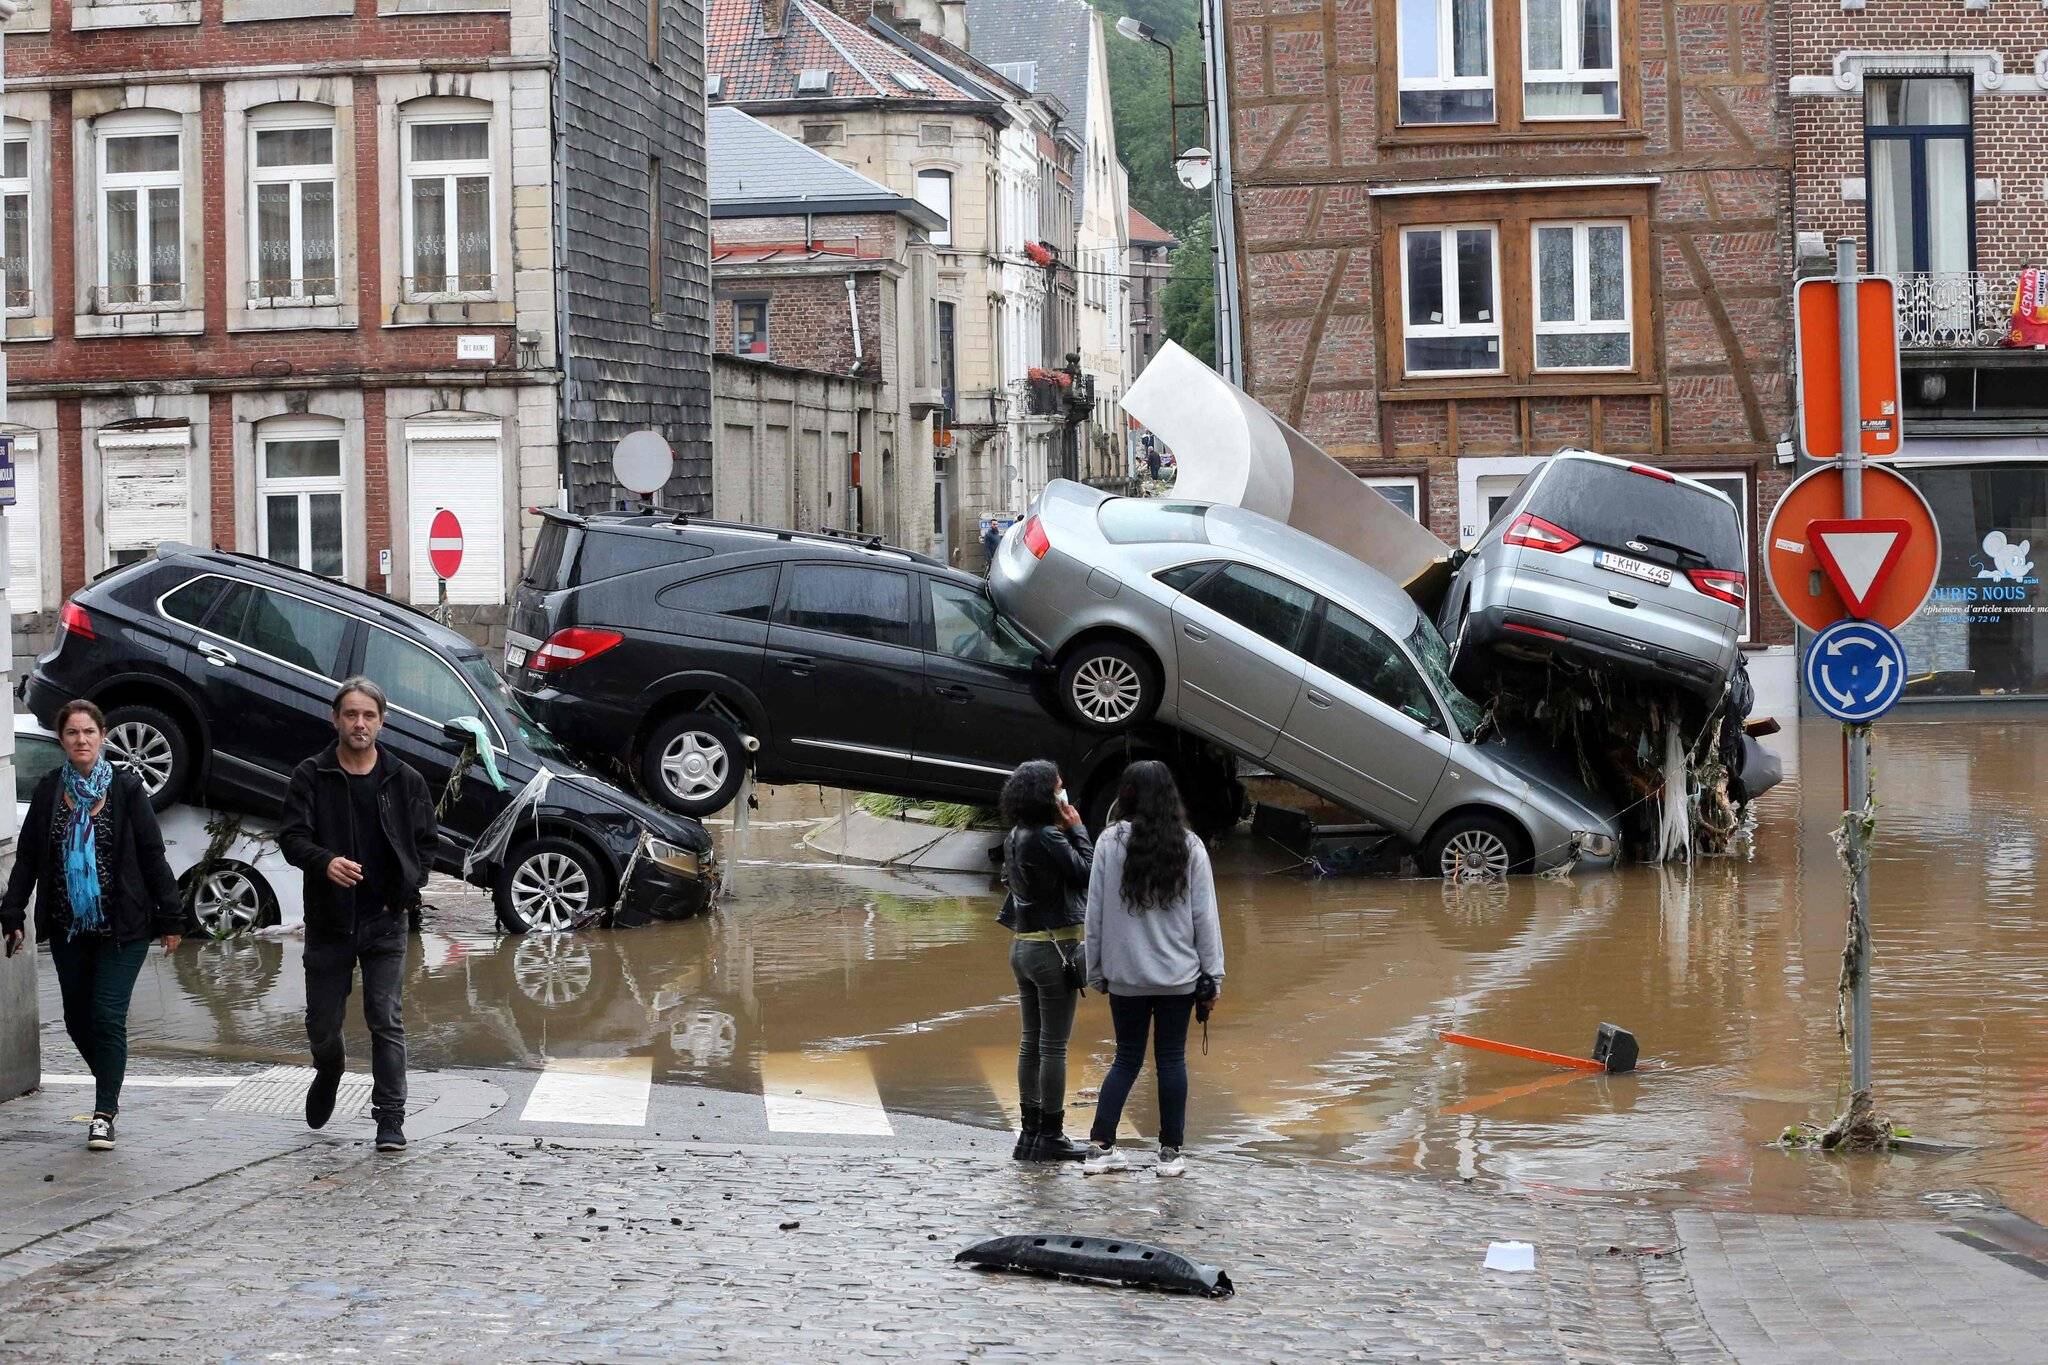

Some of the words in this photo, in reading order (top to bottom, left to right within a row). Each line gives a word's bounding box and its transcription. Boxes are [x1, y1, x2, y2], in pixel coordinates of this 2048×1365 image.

[2020, 290, 2034, 316] RED
[1464, 525, 1475, 536] 70
[382, 551, 388, 565] P
[1930, 587, 1978, 601] OURIS
[1982, 586, 2026, 600] NOUS
[1964, 604, 2002, 613] d'articles
[2004, 604, 2034, 613] seconde
